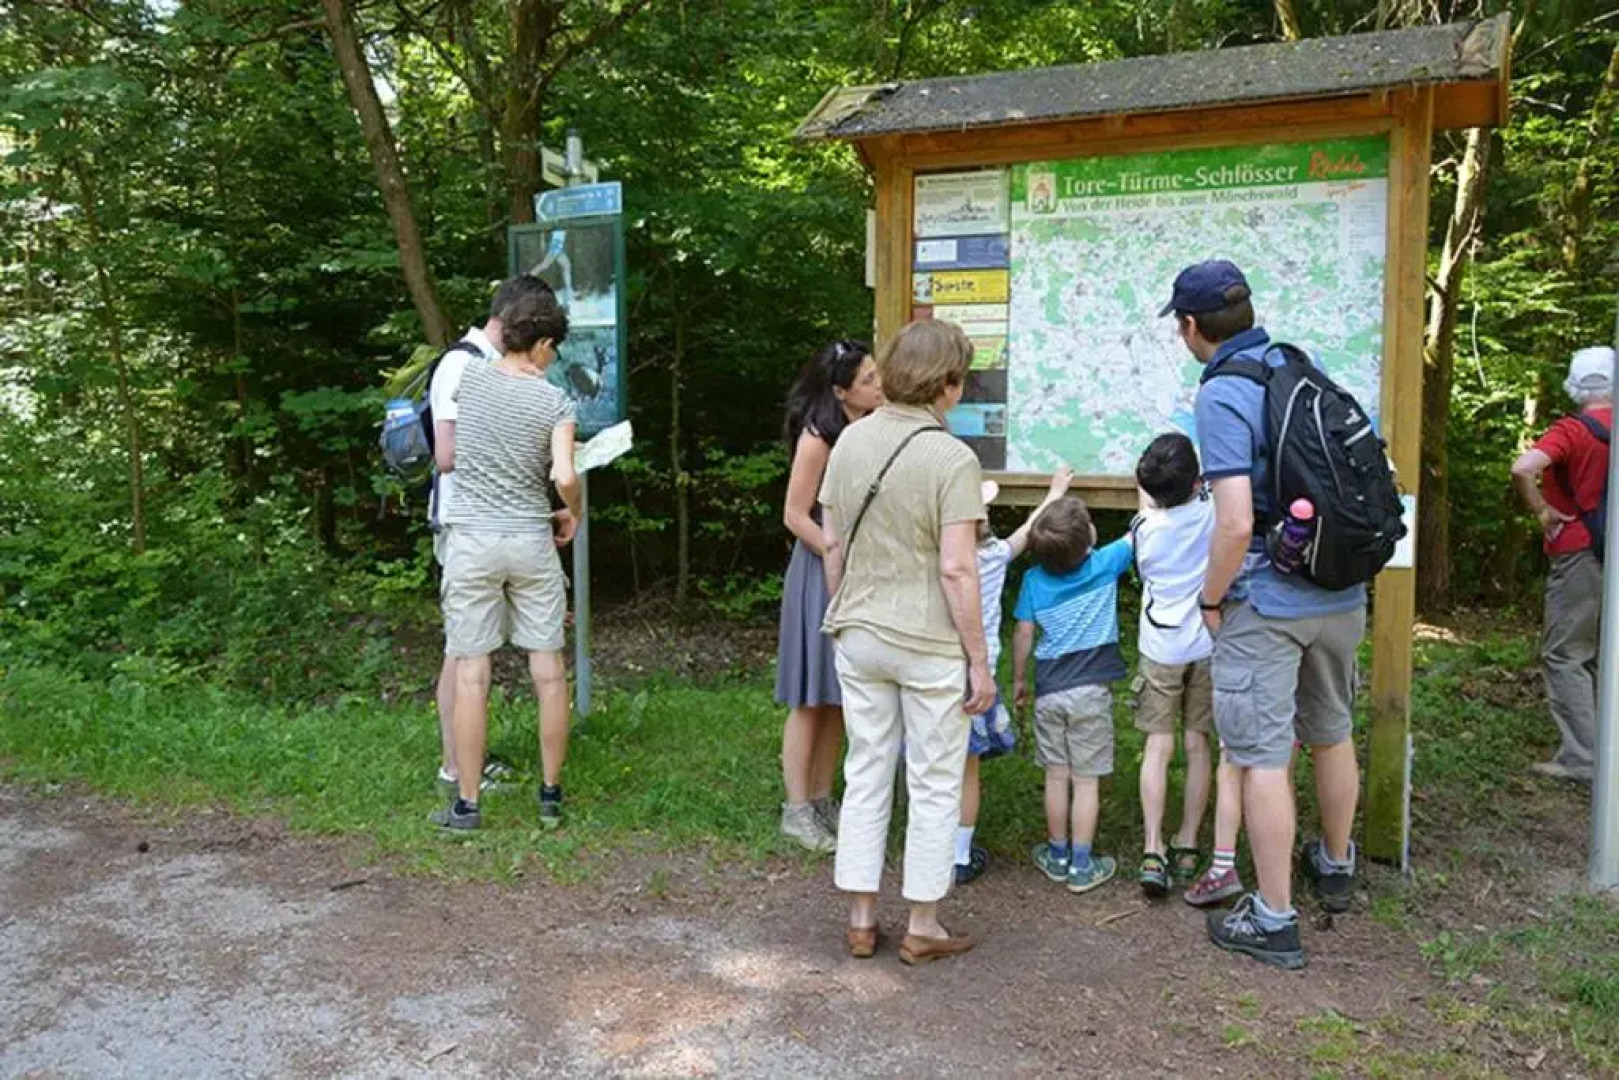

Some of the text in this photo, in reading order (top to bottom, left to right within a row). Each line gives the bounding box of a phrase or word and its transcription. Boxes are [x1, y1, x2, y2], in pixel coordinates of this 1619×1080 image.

[1063, 164, 1298, 195] Tore-Türme-Schlösser
[1061, 200, 1087, 213] Von
[1090, 197, 1111, 211] der
